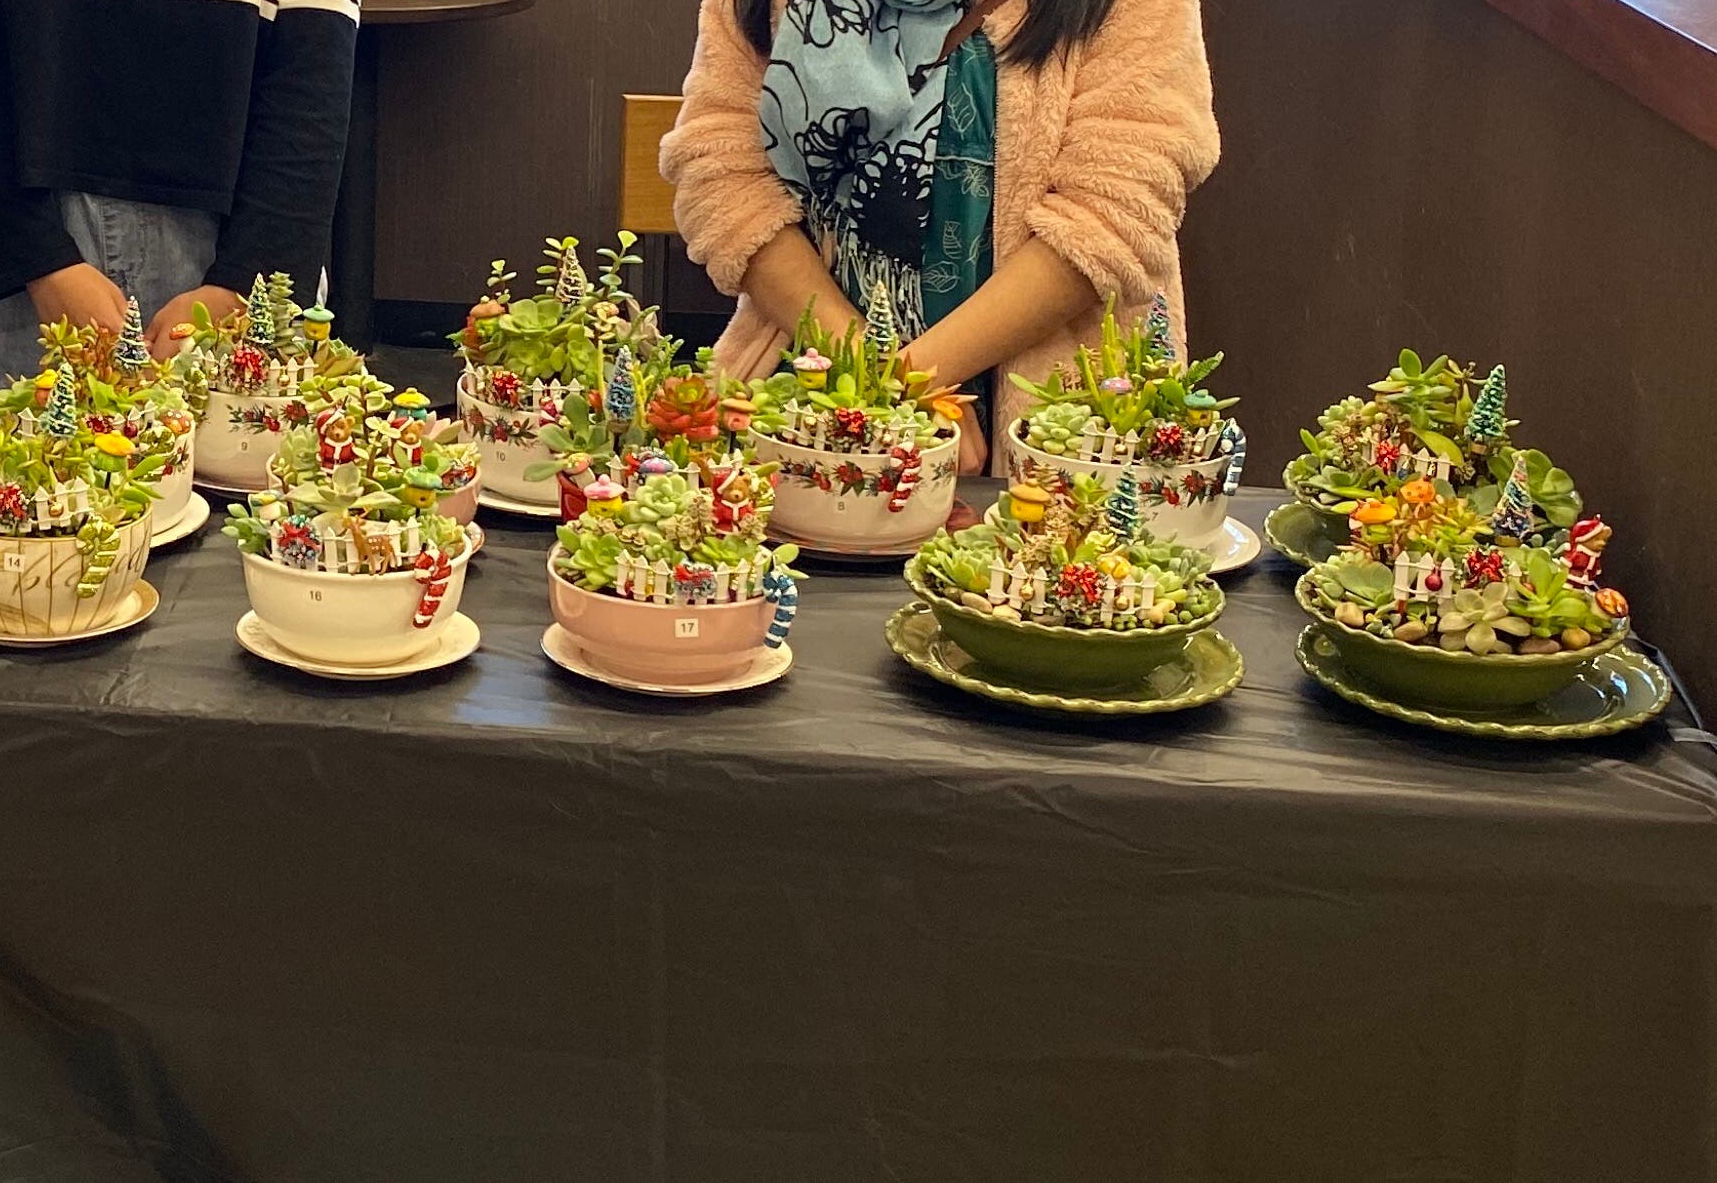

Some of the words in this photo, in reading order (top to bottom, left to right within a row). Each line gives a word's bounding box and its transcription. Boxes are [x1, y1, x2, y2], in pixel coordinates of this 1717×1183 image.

[241, 442, 248, 451] 9
[837, 501, 845, 511] 8
[7, 556, 21, 567] 14
[309, 590, 322, 602] 16
[681, 622, 695, 633] 17
